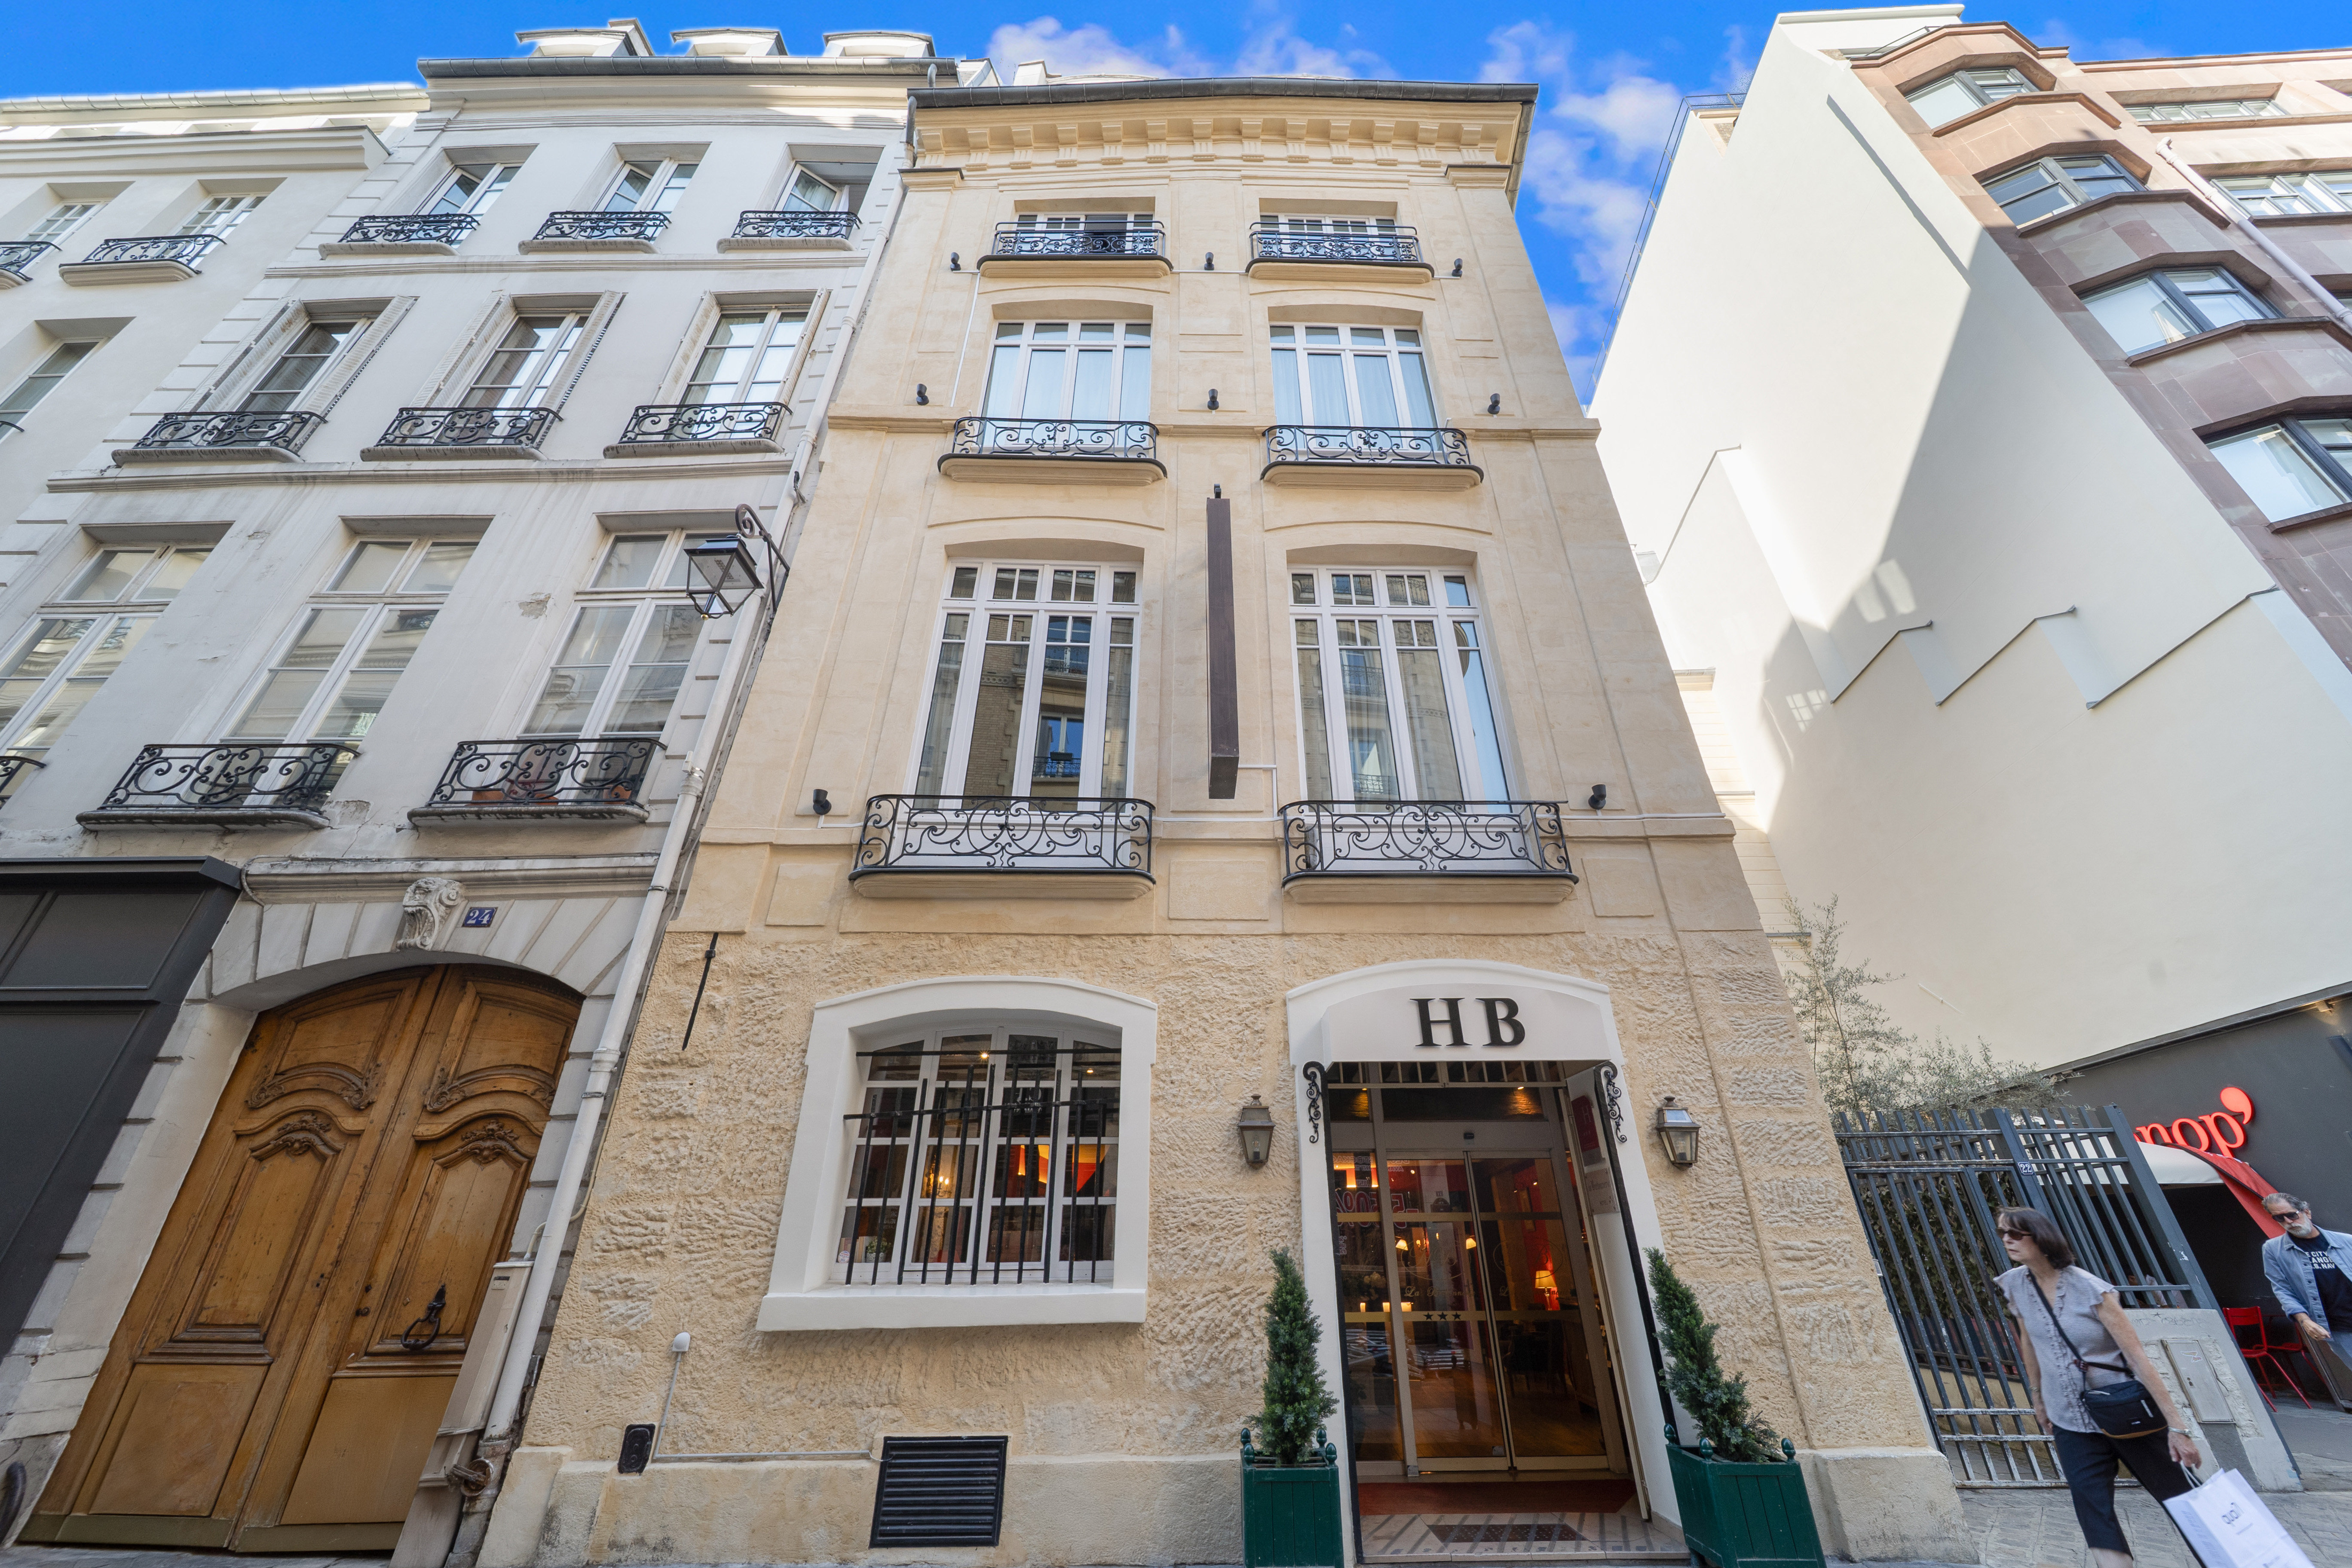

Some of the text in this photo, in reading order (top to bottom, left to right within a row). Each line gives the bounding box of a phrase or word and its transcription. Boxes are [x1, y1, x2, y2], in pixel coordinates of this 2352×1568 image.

[467, 910, 492, 924] 24
[1409, 998, 1525, 1047] HB
[2020, 1164, 2032, 1173] 22
